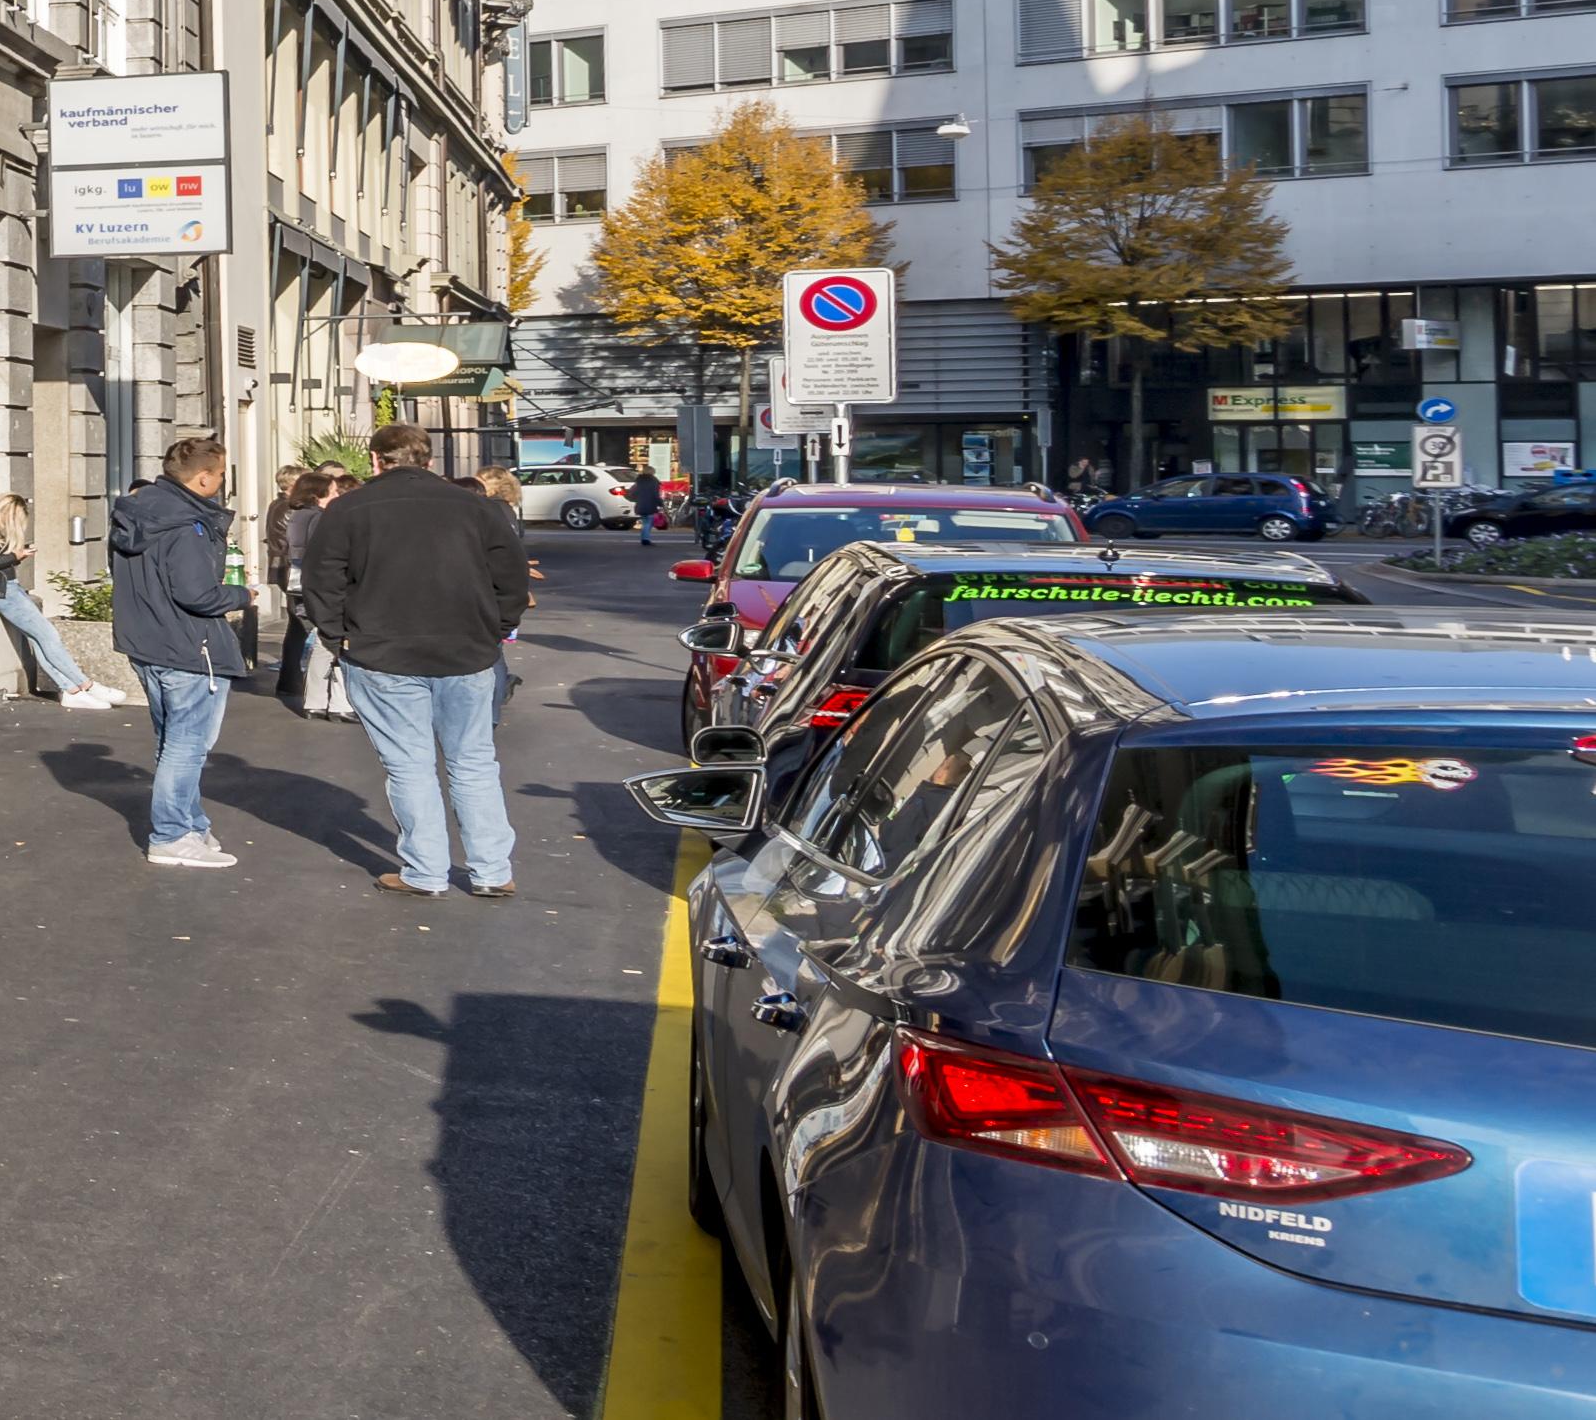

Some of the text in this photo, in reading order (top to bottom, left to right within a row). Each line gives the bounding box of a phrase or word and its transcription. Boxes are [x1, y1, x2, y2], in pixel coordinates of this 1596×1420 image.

[59, 104, 179, 119] kaufmännischer
[67, 116, 128, 128] verband
[74, 182, 199, 197] igkg. lu ow nw
[75, 222, 149, 234] KV Luzern
[88, 235, 171, 245] Berufsakademie
[1231, 394, 1306, 409] Express
[944, 585, 1314, 608] fahrschule-liechti.com
[1218, 1201, 1333, 1232] NIDFELD
[1267, 1229, 1327, 1248] KRIENS
